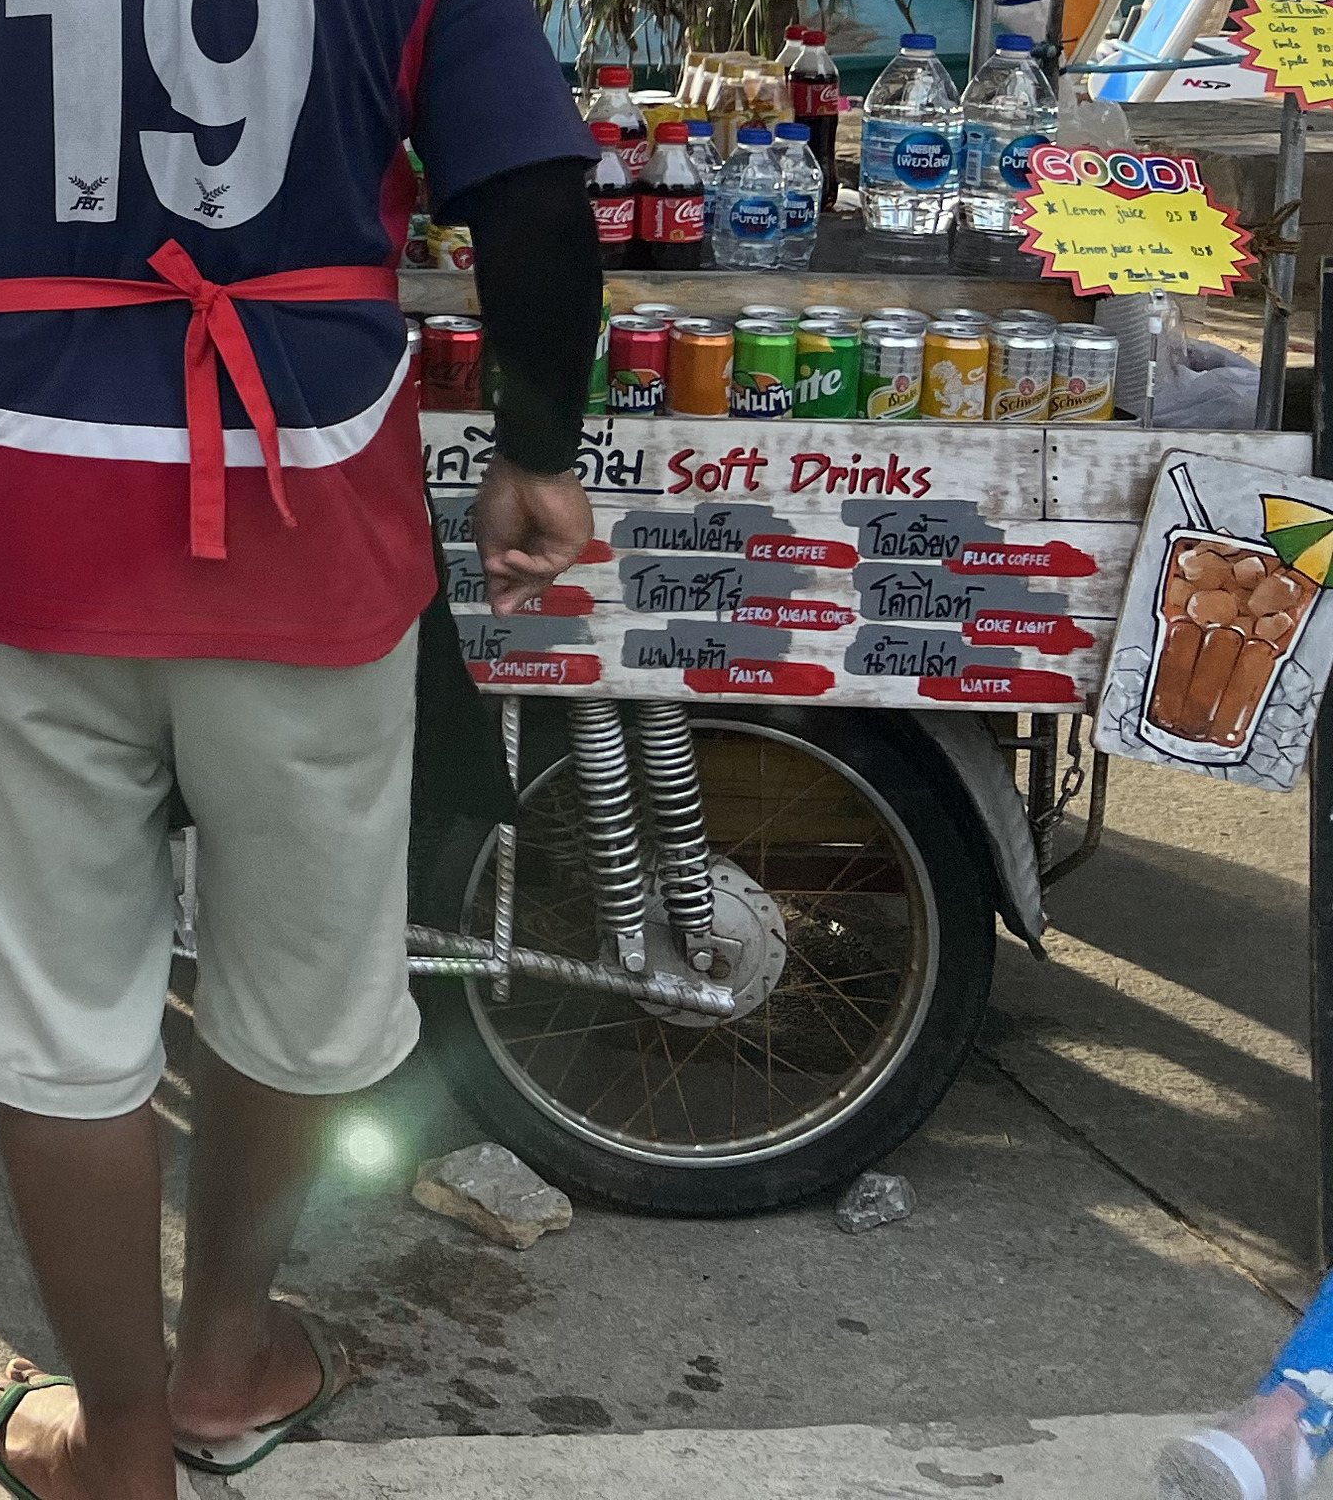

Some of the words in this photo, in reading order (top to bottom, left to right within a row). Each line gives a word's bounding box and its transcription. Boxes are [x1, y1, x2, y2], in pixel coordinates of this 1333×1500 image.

[1268, 22, 1298, 33] Coke
[1183, 79, 1231, 90] NSP
[1032, 146, 1205, 193] GOOD!
[732, 213, 758, 224] Pure
[759, 213, 778, 227] Life
[1063, 199, 1106, 216] Lemon
[1116, 205, 1146, 224] juice
[1166, 210, 1183, 222] 25
[666, 448, 768, 494] Soft
[790, 452, 932, 498] Drinks
[633, 511, 744, 551] กาแฟเย็น
[867, 512, 960, 558] โอเลี้ยง
[752, 545, 772, 558] ICE
[777, 545, 828, 560] COFFEE
[963, 551, 1004, 566] BLACK
[1007, 553, 1051, 567] COFFEE
[737, 607, 773, 622] ZERO
[776, 606, 819, 627] SUGAR
[820, 610, 851, 624] COKE
[976, 618, 1010, 633] COKE
[1015, 620, 1057, 635] LIGHT
[863, 636, 957, 678] น้ำเปล่า
[488, 658, 568, 684] SCHWEPPES
[729, 667, 774, 684] FANTA
[960, 678, 1013, 694] WATER
